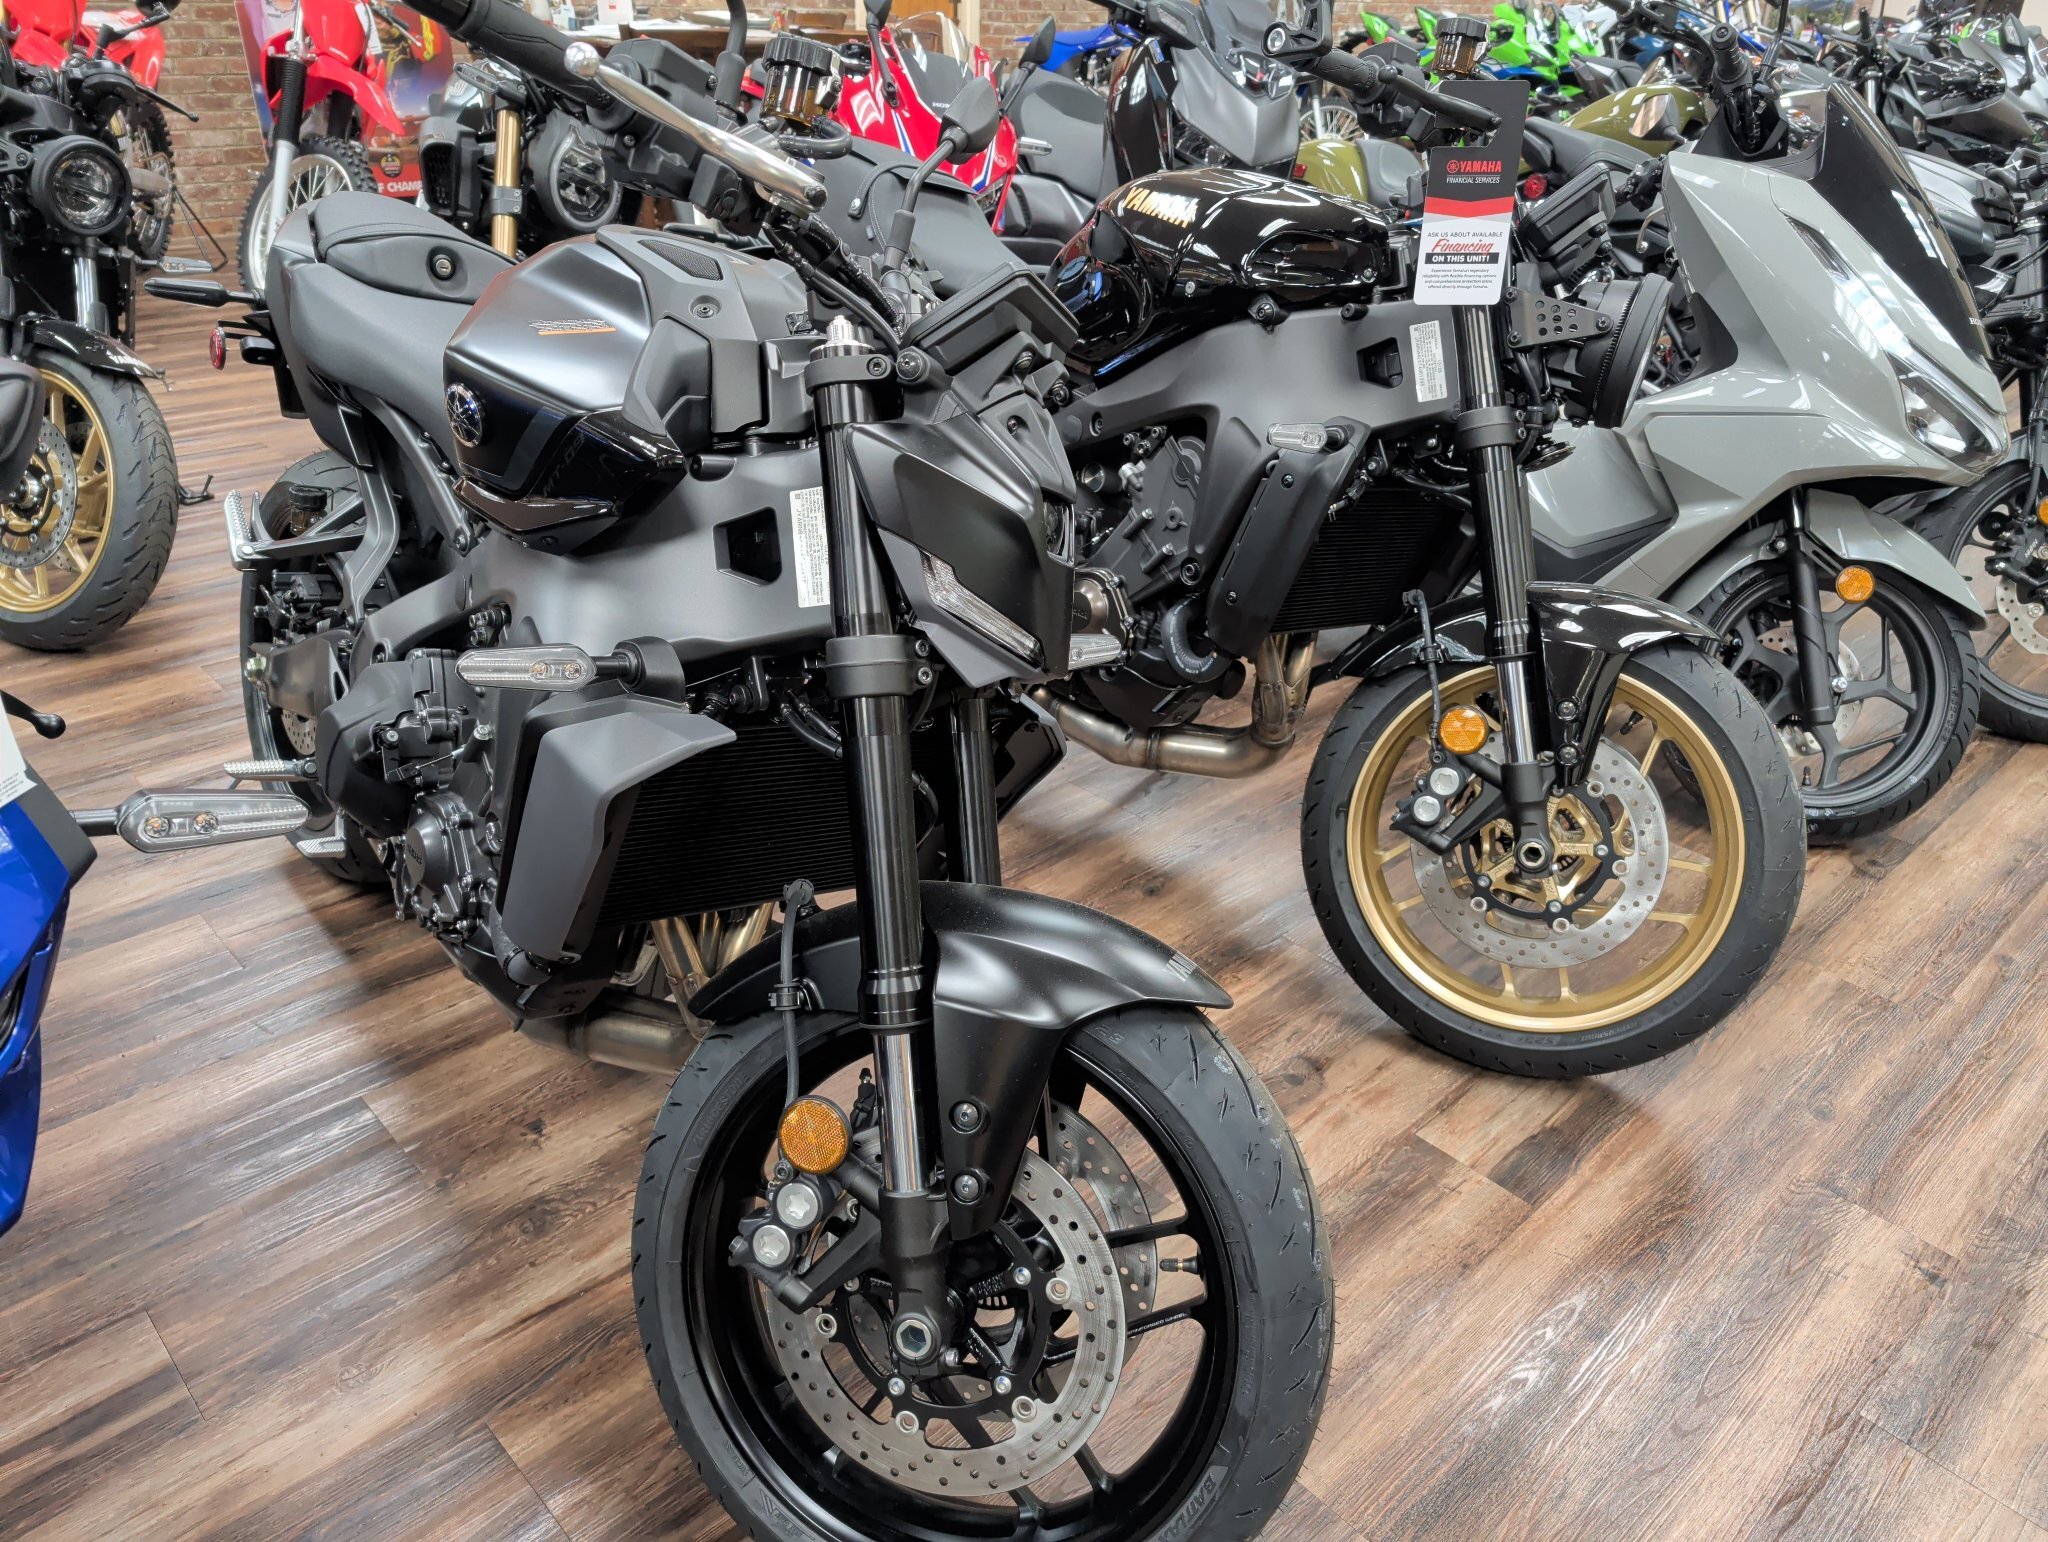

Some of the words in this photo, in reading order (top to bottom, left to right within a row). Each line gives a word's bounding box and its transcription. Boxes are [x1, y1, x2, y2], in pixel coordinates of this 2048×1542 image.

[1460, 160, 1502, 173] YAMAHA
[1446, 176, 1474, 184] FINANCIAL
[1475, 176, 1500, 184] SERVICES
[1122, 186, 1201, 229] YAMAHA
[1432, 238, 1494, 256] Financing
[543, 433, 585, 498] MT-09
